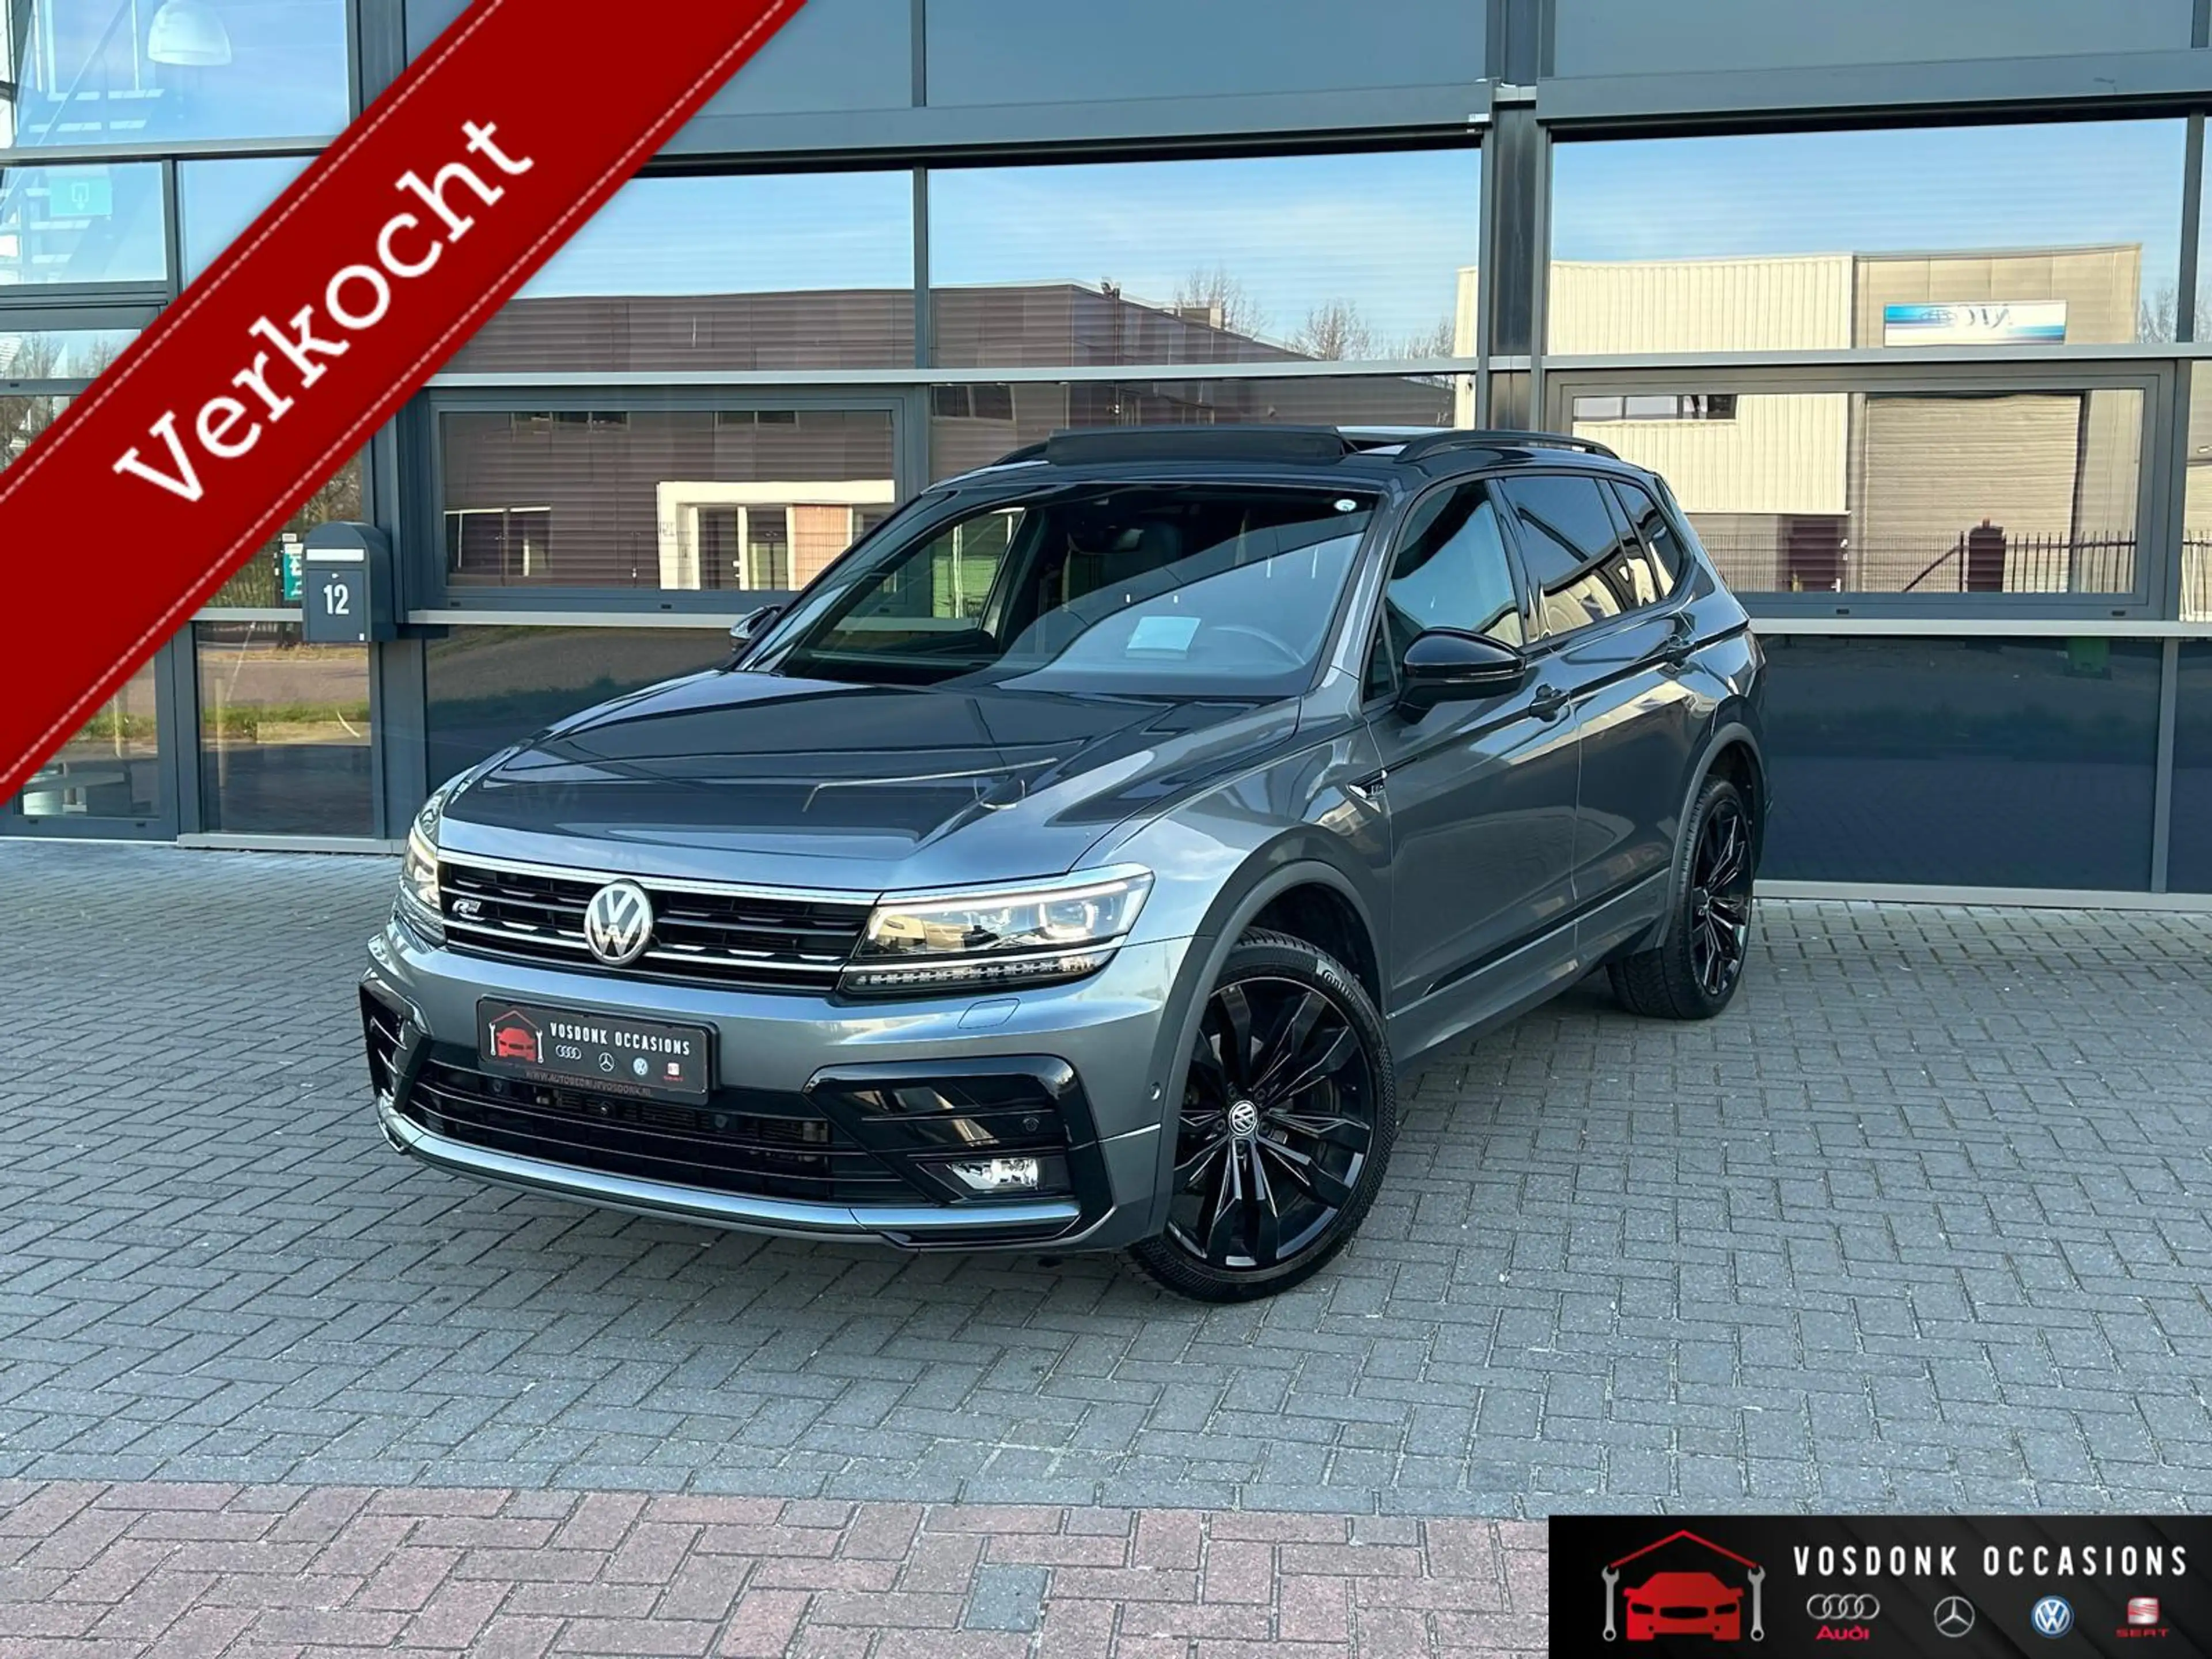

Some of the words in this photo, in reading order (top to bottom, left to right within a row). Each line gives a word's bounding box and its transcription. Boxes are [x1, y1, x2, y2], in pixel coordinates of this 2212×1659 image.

[323, 584, 349, 615] 12
[550, 1022, 608, 1046] VOSDONK
[615, 1031, 690, 1055] OCCASIONS
